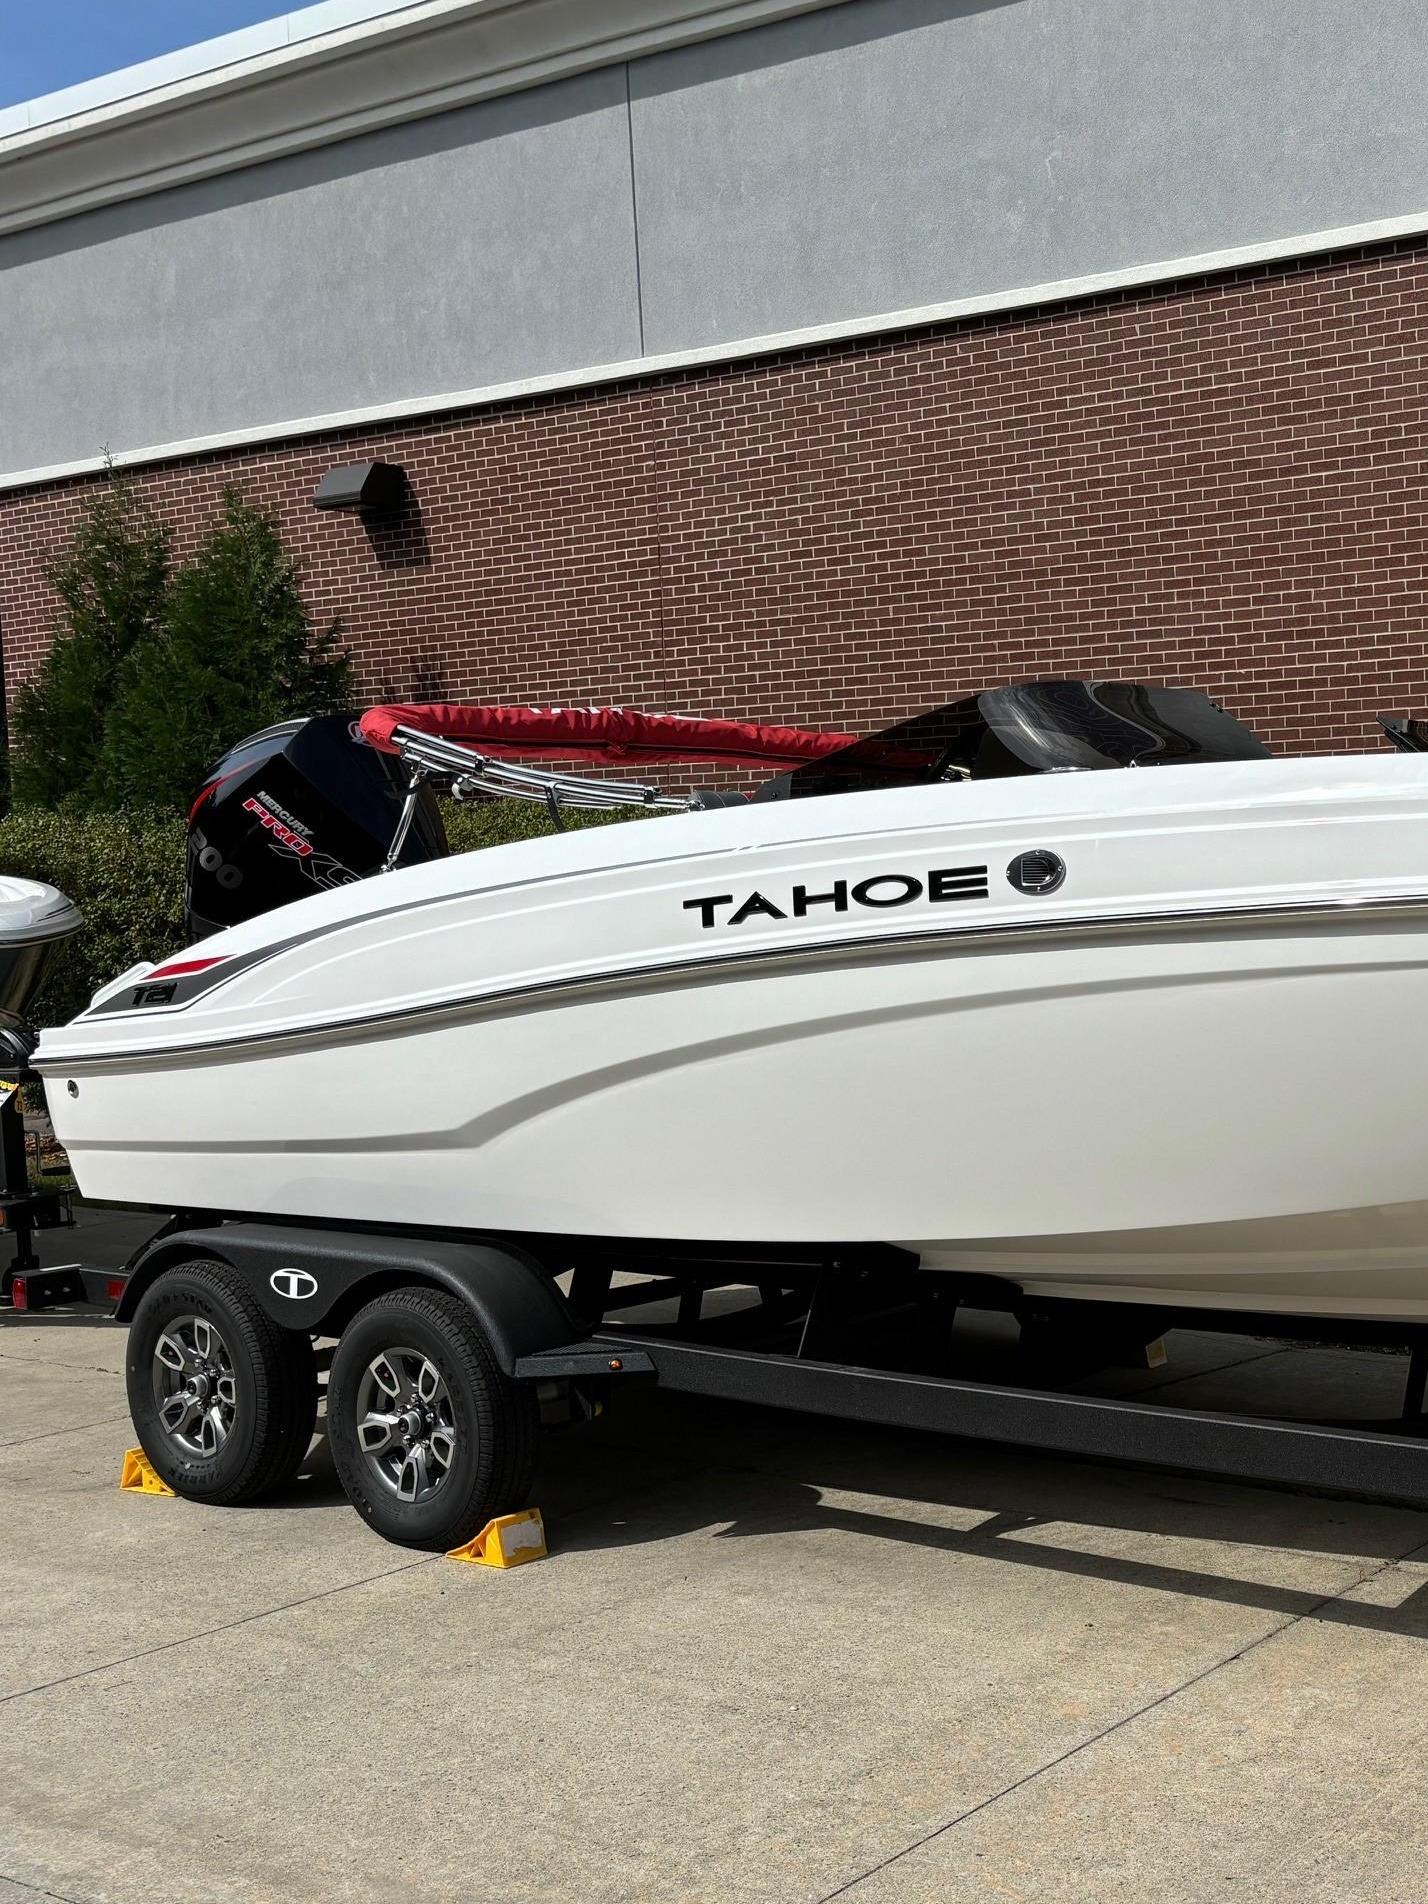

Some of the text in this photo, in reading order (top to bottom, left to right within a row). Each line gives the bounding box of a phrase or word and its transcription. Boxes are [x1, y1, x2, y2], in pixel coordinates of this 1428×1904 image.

[242, 797, 314, 857] PRO
[257, 791, 315, 837] MERCURY
[188, 826, 244, 890] 200
[682, 864, 989, 929] TAHOE
